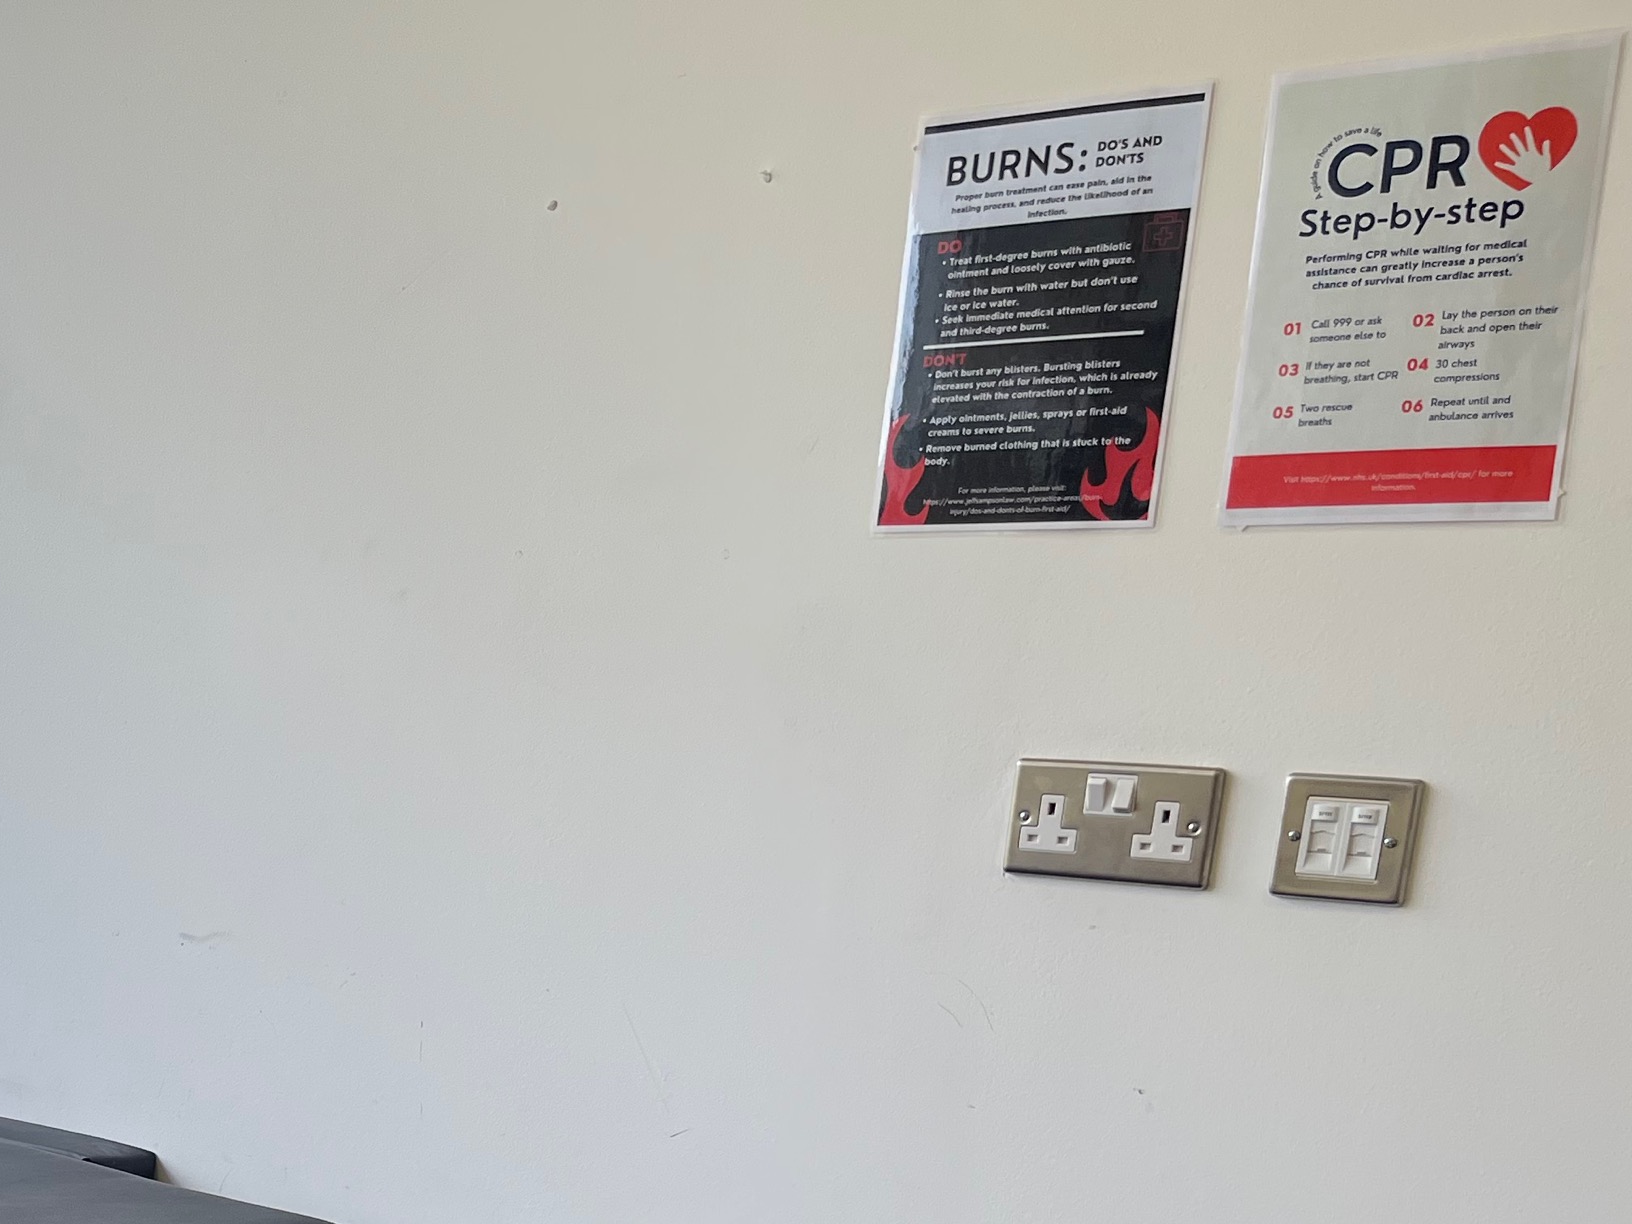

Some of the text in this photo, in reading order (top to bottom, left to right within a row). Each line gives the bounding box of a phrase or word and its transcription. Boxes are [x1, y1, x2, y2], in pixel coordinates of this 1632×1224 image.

[1097, 136, 1162, 151] DO'S AND
[946, 142, 1087, 186] BURNS:
[1096, 153, 1144, 167] DON'TS
[1328, 134, 1470, 197] CPR
[955, 193, 982, 202] Proper
[985, 190, 1003, 198] burn
[1006, 185, 1046, 196] treatment
[1087, 178, 1108, 189] pain,
[1111, 176, 1124, 184] aid
[1137, 174, 1152, 182] the
[1299, 198, 1524, 240] Step-by-step
[938, 240, 962, 254] DO
[1306, 239, 1527, 264] Performing CPR while waiting for medical
[949, 242, 1131, 267] Treat first-degree burns with antibiotic
[948, 256, 1135, 279] ointment and loosely cover with gauze.
[1306, 266, 1357, 277] assistance
[1360, 265, 1378, 273] can
[1381, 260, 1418, 273] greatly
[1422, 259, 1465, 269] increase
[1477, 254, 1523, 267] person's
[1312, 268, 1512, 290] chance of survival from cardiac arrest.
[945, 276, 1138, 298] Rinse the burn with water but don't use
[942, 300, 1158, 325] Seek immediate medical attention for second
[944, 299, 1020, 312] ice or ice water.
[1413, 314, 1435, 327] 02
[1442, 305, 1559, 322] Lay the person on their
[940, 322, 1050, 337] and third-degree burns.
[1283, 322, 1302, 336] 01
[1311, 316, 1382, 329] Call 999 or ask
[1440, 321, 1542, 335] back and open their
[1309, 330, 1386, 344] someone else to
[1438, 339, 1475, 350] airways
[923, 353, 967, 367] DON'T
[1305, 358, 1370, 372] If they are not
[1407, 358, 1430, 371] 04
[1436, 358, 1477, 369] 30 chest
[935, 360, 1120, 379] Don't burst any blisters. Bursting blisters
[1279, 363, 1299, 377] 03
[933, 370, 1158, 391] increases your risk for infection, which is already
[1304, 370, 1399, 386] breathing, start CPR
[1434, 371, 1500, 384] compressions
[932, 393, 970, 403] elevated
[972, 392, 992, 401] with
[995, 391, 1009, 400] the
[1012, 388, 1064, 399] contraction
[1067, 387, 1077, 396] of
[1087, 386, 1112, 395] burn.
[1431, 395, 1511, 408] Repeat until and
[1273, 406, 1294, 420] 05
[1300, 403, 1353, 413] Two rescue
[1402, 400, 1423, 414] 06
[929, 406, 1127, 425] Apply ointments, jellies, sprays or first-aid
[1298, 417, 1332, 427] breaths
[1429, 409, 1514, 422] anbulance arrives
[928, 424, 1035, 436] creams to severe burns.
[926, 436, 1131, 454] Remove burned clothing that is stuck to the
[924, 457, 950, 468] body.
